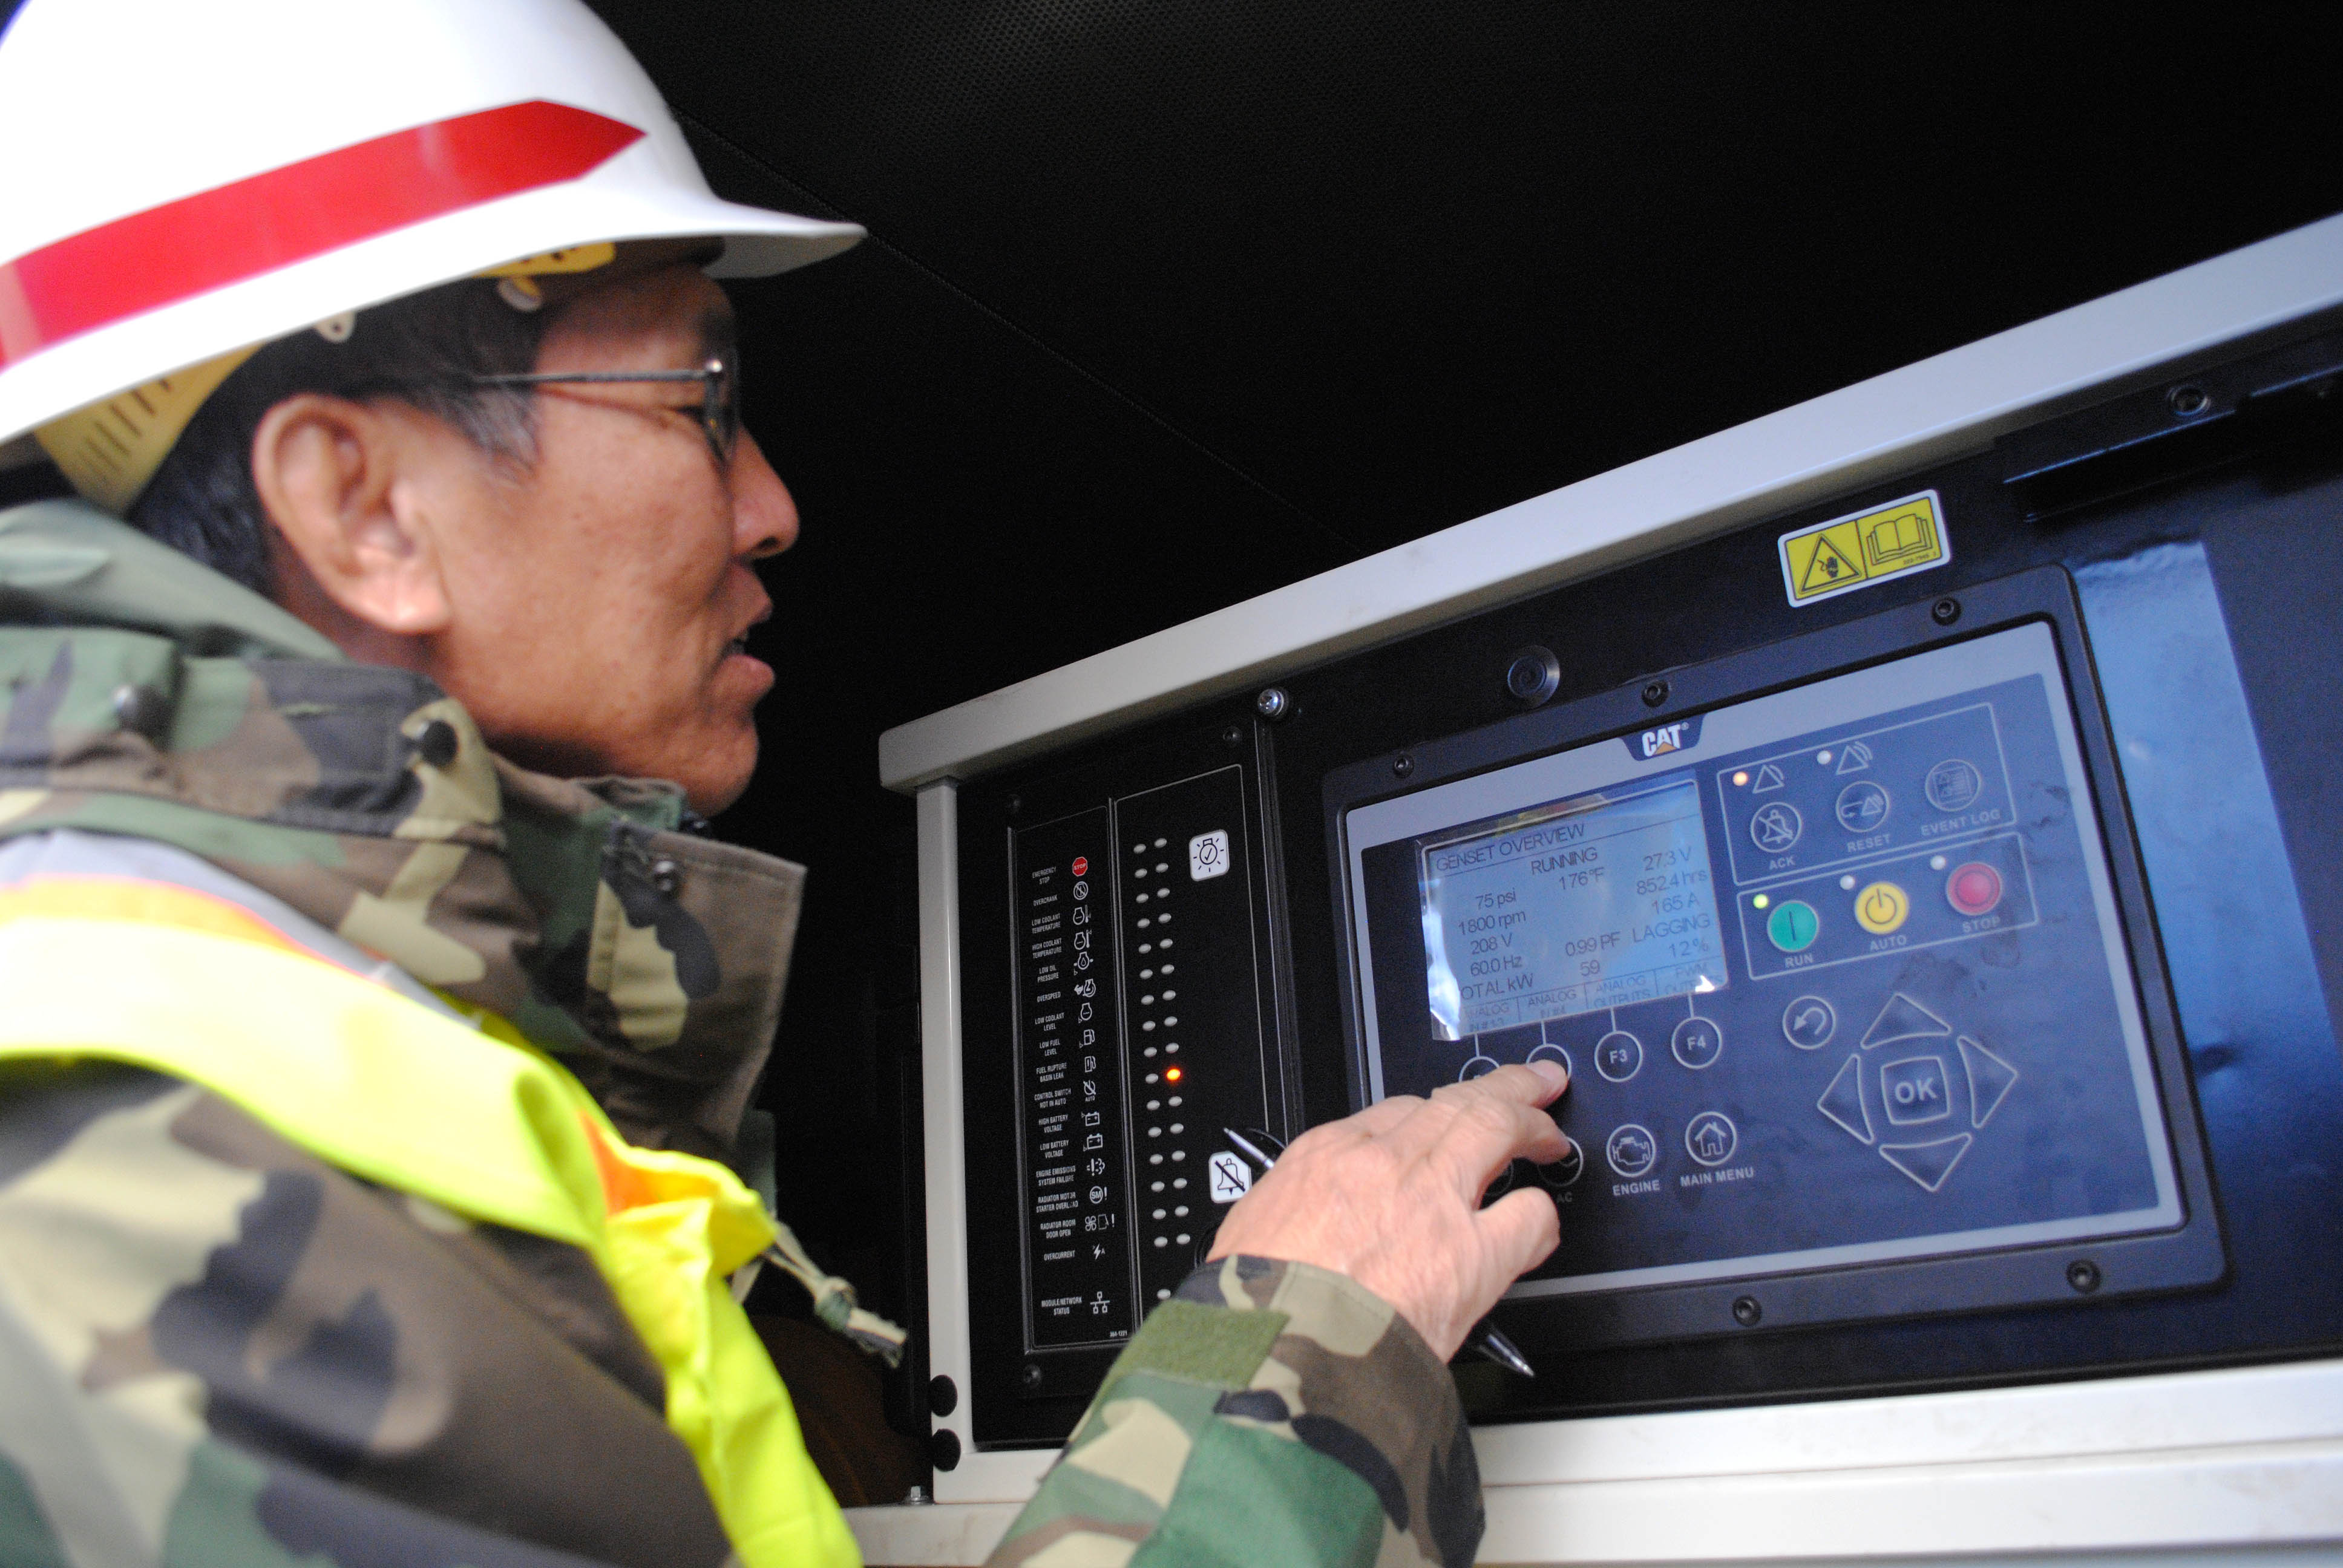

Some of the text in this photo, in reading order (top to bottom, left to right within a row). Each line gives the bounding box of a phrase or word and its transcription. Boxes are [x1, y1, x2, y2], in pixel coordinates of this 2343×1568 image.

[1921, 808, 2001, 836] EVENT LOG
[1436, 823, 1585, 871] GENSET OVERVIEW
[1847, 834, 1890, 852] RESET
[1531, 846, 1598, 875] RUNNING
[1678, 846, 1691, 862] V
[1769, 856, 1795, 870] ACK
[1032, 866, 1057, 878] EMERGENCY
[1682, 870, 1708, 886] hrs
[1033, 894, 1058, 906] OVERCRANK
[1475, 887, 1517, 910] 75 psi
[1652, 892, 1699, 915] 165 A
[1042, 913, 1061, 924] COOLANT
[1458, 910, 1526, 935] 1800 rpm
[1962, 916, 2001, 933] STOP
[1032, 921, 1061, 934] TEMPERATURE
[1632, 912, 1711, 942] LAGGING
[1043, 938, 1062, 948] COOLANT
[1470, 932, 1513, 955] 208 V
[1599, 931, 1620, 949] PF
[1870, 935, 1907, 950] AUTO
[1033, 946, 1062, 959] TEMPERATURE
[1503, 955, 1523, 970] Hz
[1785, 953, 1814, 968] RUN
[1580, 959, 1601, 977] 59
[1037, 972, 1059, 982] PRESSURE
[1597, 975, 1646, 992] ANALOG
[1460, 973, 1534, 1000] OTAL kW
[1037, 991, 1061, 1002] OVERSPEED
[1528, 988, 1577, 1007] ANALOG
[1045, 1012, 1064, 1022] COOLANT
[1686, 1035, 1706, 1051] F4
[1610, 1049, 1628, 1064] F3
[1047, 1062, 1067, 1072] RUPTURE
[1053, 1071, 1064, 1080] LEAK
[1034, 1088, 1071, 1100] CONTROL SWITCH
[1895, 1078, 1938, 1103] OK
[1050, 1114, 1069, 1123] BATTERY
[1044, 1124, 1063, 1133] VOLTAGE
[1050, 1140, 1069, 1149] BATTERY
[1044, 1149, 1063, 1158] VOLTAGE
[1036, 1165, 1076, 1178] ENGINE EMISSIONS
[1680, 1166, 1755, 1187] MAIN MENU
[1038, 1175, 1075, 1186] SYSTEM FAILURE
[1612, 1180, 1660, 1196] ENGINE
[1038, 1192, 1076, 1203] RADIATOR MOTOR
[1036, 1204, 1055, 1213] STARTER
[1040, 1219, 1076, 1230] RADIATOR ROOM
[1059, 1229, 1071, 1237] OPEN
[1044, 1250, 1075, 1261] OVERCURRENT
[1054, 1307, 1070, 1316] STATUS
